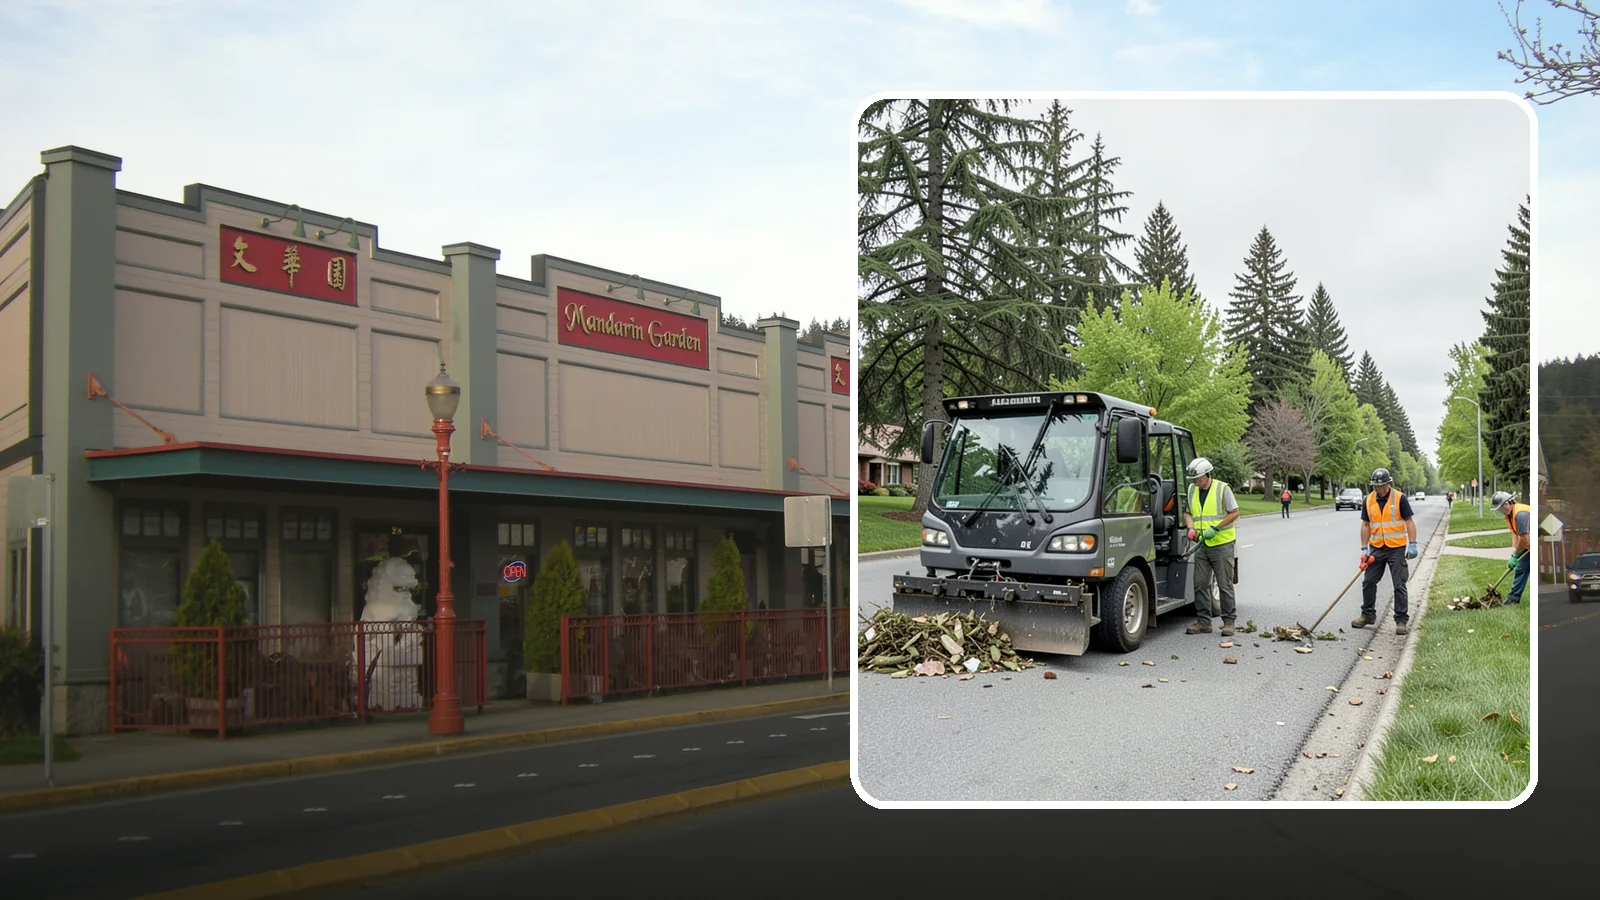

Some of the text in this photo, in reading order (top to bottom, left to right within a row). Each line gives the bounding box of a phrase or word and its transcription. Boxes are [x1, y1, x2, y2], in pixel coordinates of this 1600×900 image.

[230, 235, 346, 291] 文華園
[564, 302, 702, 352] Mandarin Garden
[503, 565, 527, 578] OPEN
